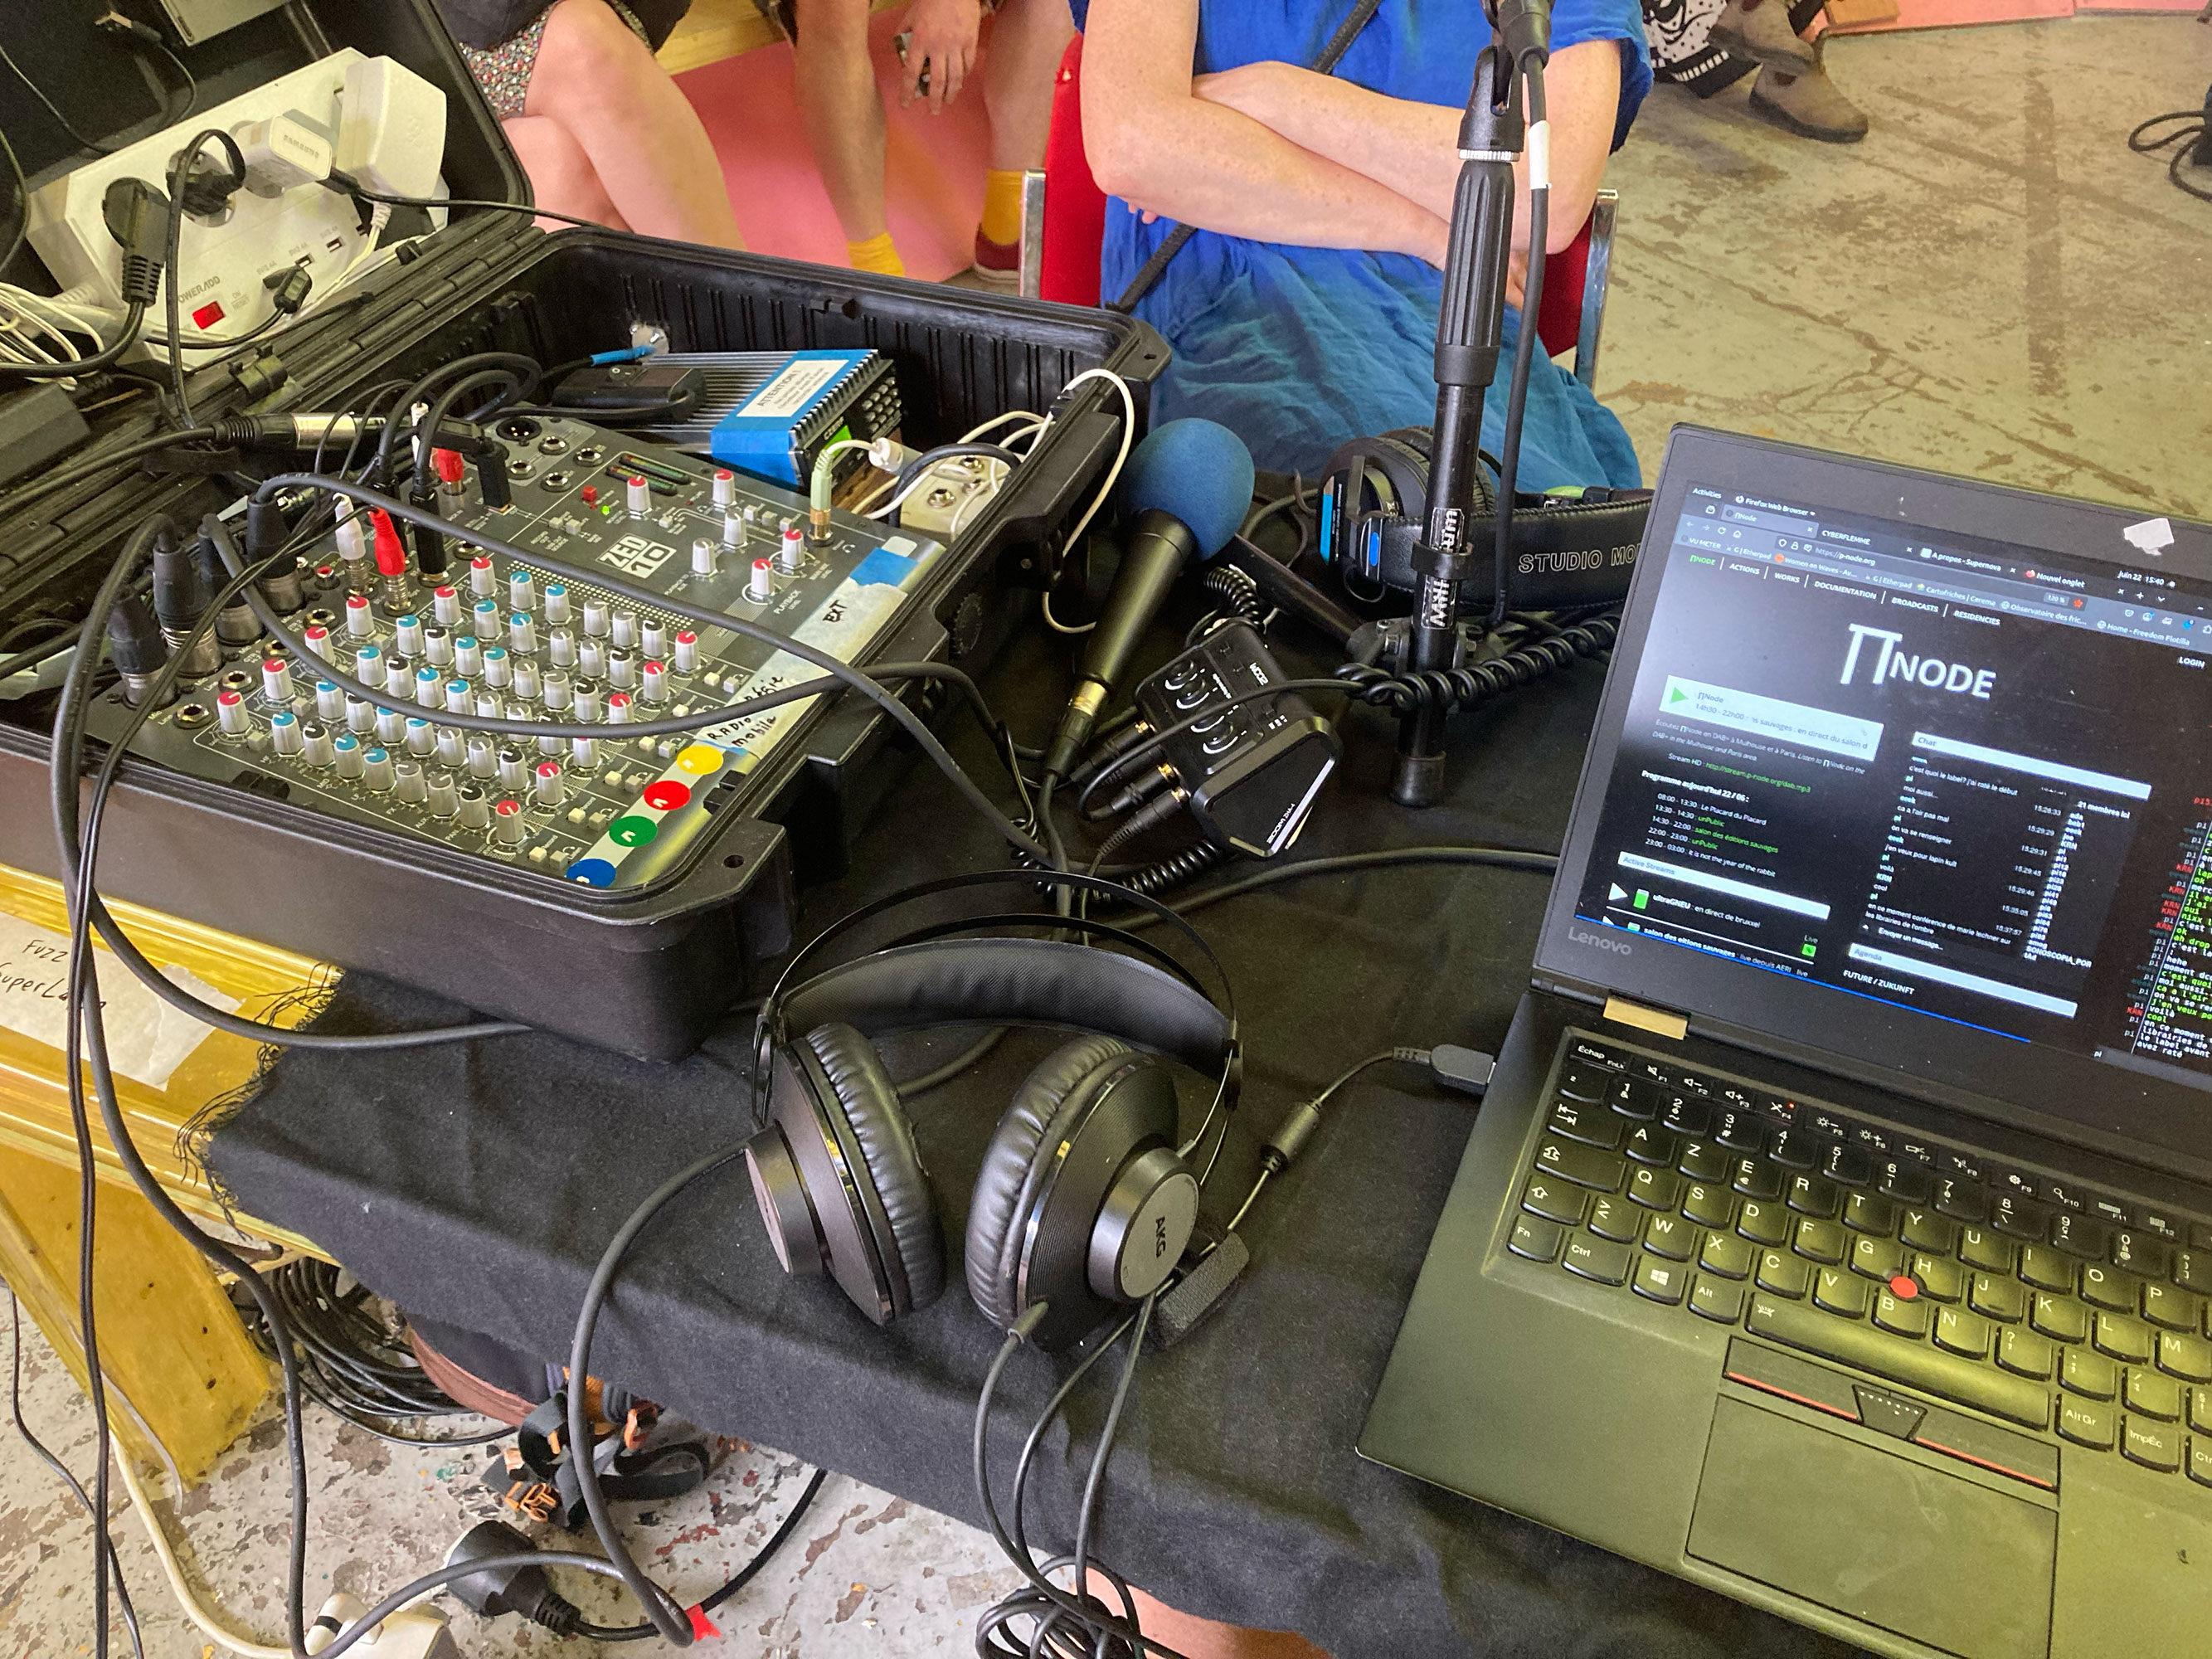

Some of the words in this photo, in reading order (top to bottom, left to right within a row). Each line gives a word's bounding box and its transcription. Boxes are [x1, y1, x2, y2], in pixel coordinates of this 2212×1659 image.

[178, 275, 221, 304] OWERADD
[756, 373, 795, 407] ATTENTION
[1693, 488, 1722, 499] Activities
[1745, 498, 1767, 509] Firefox
[1767, 502, 1782, 511] Web
[1783, 504, 1809, 517] Browser
[1689, 537, 1699, 545] VU
[1699, 538, 1721, 549] METER
[1822, 529, 1871, 545] CYBERFLEMME
[600, 535, 648, 567] ZED
[631, 546, 670, 572] 10
[1517, 550, 1604, 574] STUDIO
[1785, 555, 1808, 567] Women
[1819, 562, 1839, 573] Waves
[1939, 552, 1962, 565] propos
[1966, 557, 2001, 572] Supernova
[1729, 562, 1760, 575] ACTIONS
[1774, 572, 1801, 583] WORKS
[2036, 572, 2061, 584] Nouvel
[2062, 577, 2086, 588] onglet
[2117, 570, 2132, 581] Juin
[2132, 573, 2142, 581] 22
[2145, 576, 2165, 586] 15:40
[1814, 581, 1877, 600] DOCUMENTATION
[1926, 586, 1966, 601] Cartofriches
[1970, 594, 1996, 606] Cerema
[774, 590, 801, 614] PLAYBACK
[2048, 594, 2059, 602] 120
[823, 600, 848, 623] EXT
[1891, 596, 1939, 615] BROADCASTS
[2010, 603, 2054, 619] Observatoire
[2055, 611, 2068, 620] des
[1953, 609, 2001, 626] RESIDENCIES
[2107, 622, 2126, 634] Home
[2132, 627, 2164, 642] Freedom
[2179, 655, 2205, 669] LOGIN
[707, 718, 751, 740] RADIO
[732, 716, 776, 747] mobile
[1760, 718, 1792, 732] sauvages
[1808, 728, 1829, 742] direct
[1830, 734, 1840, 742] du
[1841, 736, 1861, 747] salon
[1918, 737, 1937, 748] Chat
[1668, 752, 1690, 765] Stream
[1641, 770, 1682, 786] Programme
[1998, 784, 2018, 796] début
[1698, 815, 1725, 828] unPublic
[1709, 805, 1733, 818] Placard
[1733, 810, 1743, 820] du
[1743, 814, 1767, 826] Placard
[1266, 817, 1286, 844] ZOOM
[1691, 838, 1719, 850] unPublic
[1694, 825, 1712, 837] salon
[1713, 830, 1723, 840] des
[1750, 839, 1778, 854] sauvages
[1622, 855, 1645, 868] Active
[1646, 861, 1675, 876] Streams
[1700, 851, 1710, 861] not
[1712, 854, 1722, 864] the
[1723, 858, 1738, 870] year
[1757, 864, 1776, 878] rabbit
[1652, 893, 1691, 910] ultraGNEU
[1705, 906, 1724, 920] direct
[1886, 905, 1912, 918] moment
[1912, 910, 1947, 928] conférence
[1568, 927, 1632, 957] Lenovo
[1644, 927, 1663, 939] salon
[1664, 932, 1676, 942] des
[1703, 942, 1735, 959] sauvages
[1804, 934, 1818, 944] Live
[1854, 946, 1883, 962] Agenda
[2166, 955, 2188, 966] hehe
[1842, 968, 1874, 986] FUTURE
[1877, 976, 1915, 996] ZUKUNFT
[1578, 1045, 1604, 1058] Échap
[2137, 1040, 2158, 1052] avez
[2162, 1046, 2183, 1058] raté
[2184, 1045, 2210, 1058] avant
[1623, 1082, 1631, 1092] 1
[1672, 1098, 1682, 1111] 2
[1726, 1114, 1734, 1123] 3
[1636, 1129, 1646, 1141] A
[1779, 1131, 1787, 1140] 4
[1688, 1144, 1700, 1156] Z
[1833, 1146, 1840, 1155] 5
[1742, 1160, 1753, 1173] E
[1889, 1164, 1896, 1173] 6
[1638, 1170, 1652, 1184] Q
[1796, 1177, 1809, 1190] R
[1692, 1187, 1704, 1199] S
[1945, 1180, 1953, 1193] 7
[1854, 1194, 1865, 1207] T
[2002, 1199, 2010, 1208] 8
[1746, 1204, 1759, 1216] D
[1656, 1218, 1673, 1233] W
[1910, 1213, 1922, 1224] Y
[2062, 1217, 2070, 1226] 9
[1518, 1227, 1530, 1237] Fn
[1802, 1222, 1814, 1233] F
[1154, 1215, 1168, 1259] AKG
[1709, 1236, 1723, 1250] X
[1968, 1231, 1980, 1243] U
[2122, 1235, 2130, 1248] 0
[1572, 1245, 1590, 1257] Ctrl
[1860, 1241, 1873, 1254] G
[1767, 1255, 1780, 1268] C
[1918, 1258, 1931, 1272] H
[1826, 1273, 1838, 1287] V
[1979, 1280, 1988, 1291] J
[1699, 1287, 1712, 1297] Alt
[2151, 1287, 2161, 1298] P
[1882, 1297, 1894, 1311] B
[2040, 1297, 2052, 1311] K
[1943, 1311, 1956, 1326] N
[2101, 1317, 2112, 1331] L
[2166, 1337, 2180, 1352] M
[2129, 1429, 2163, 1448] ImpÉc
